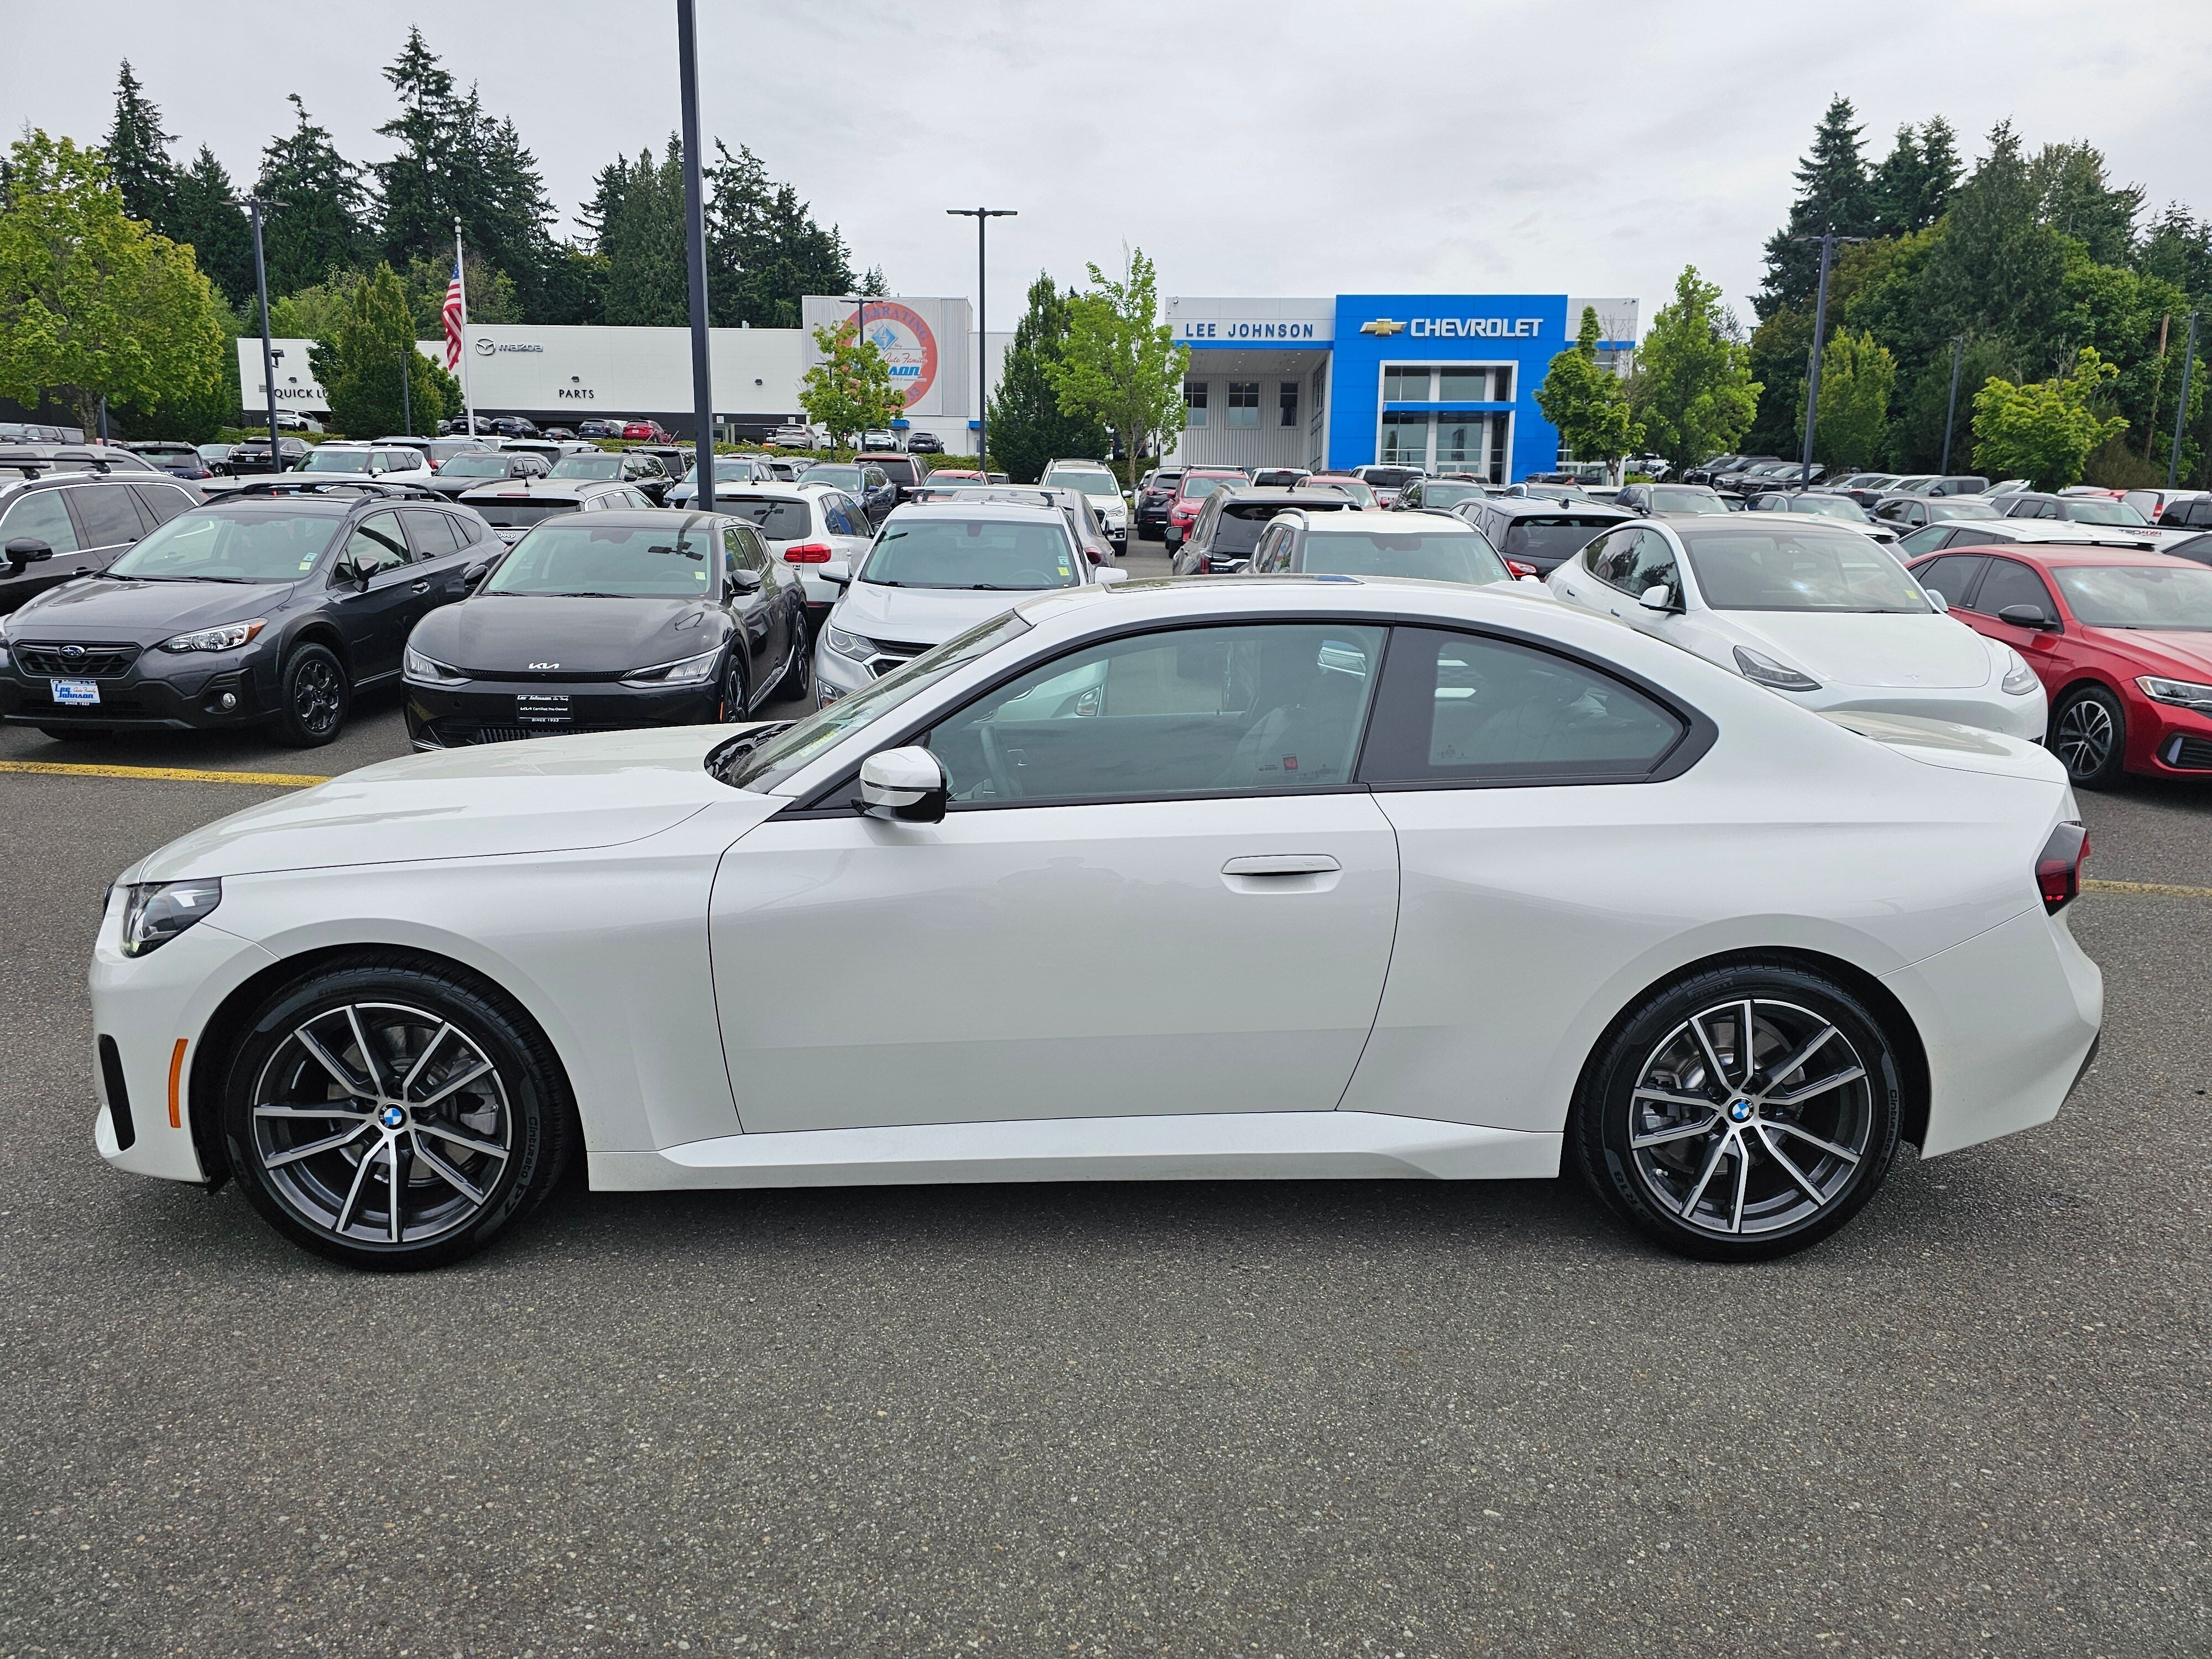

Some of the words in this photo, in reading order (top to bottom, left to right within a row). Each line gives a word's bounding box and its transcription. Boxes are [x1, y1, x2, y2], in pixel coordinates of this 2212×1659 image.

[1186, 324, 1216, 337] LEE
[1228, 324, 1313, 337] JOHNSON
[1411, 319, 1543, 337] CHEVROLET
[902, 352, 927, 367] Family
[275, 389, 314, 399] QUICK
[559, 389, 594, 399] PARTS
[55, 684, 72, 692] Lee
